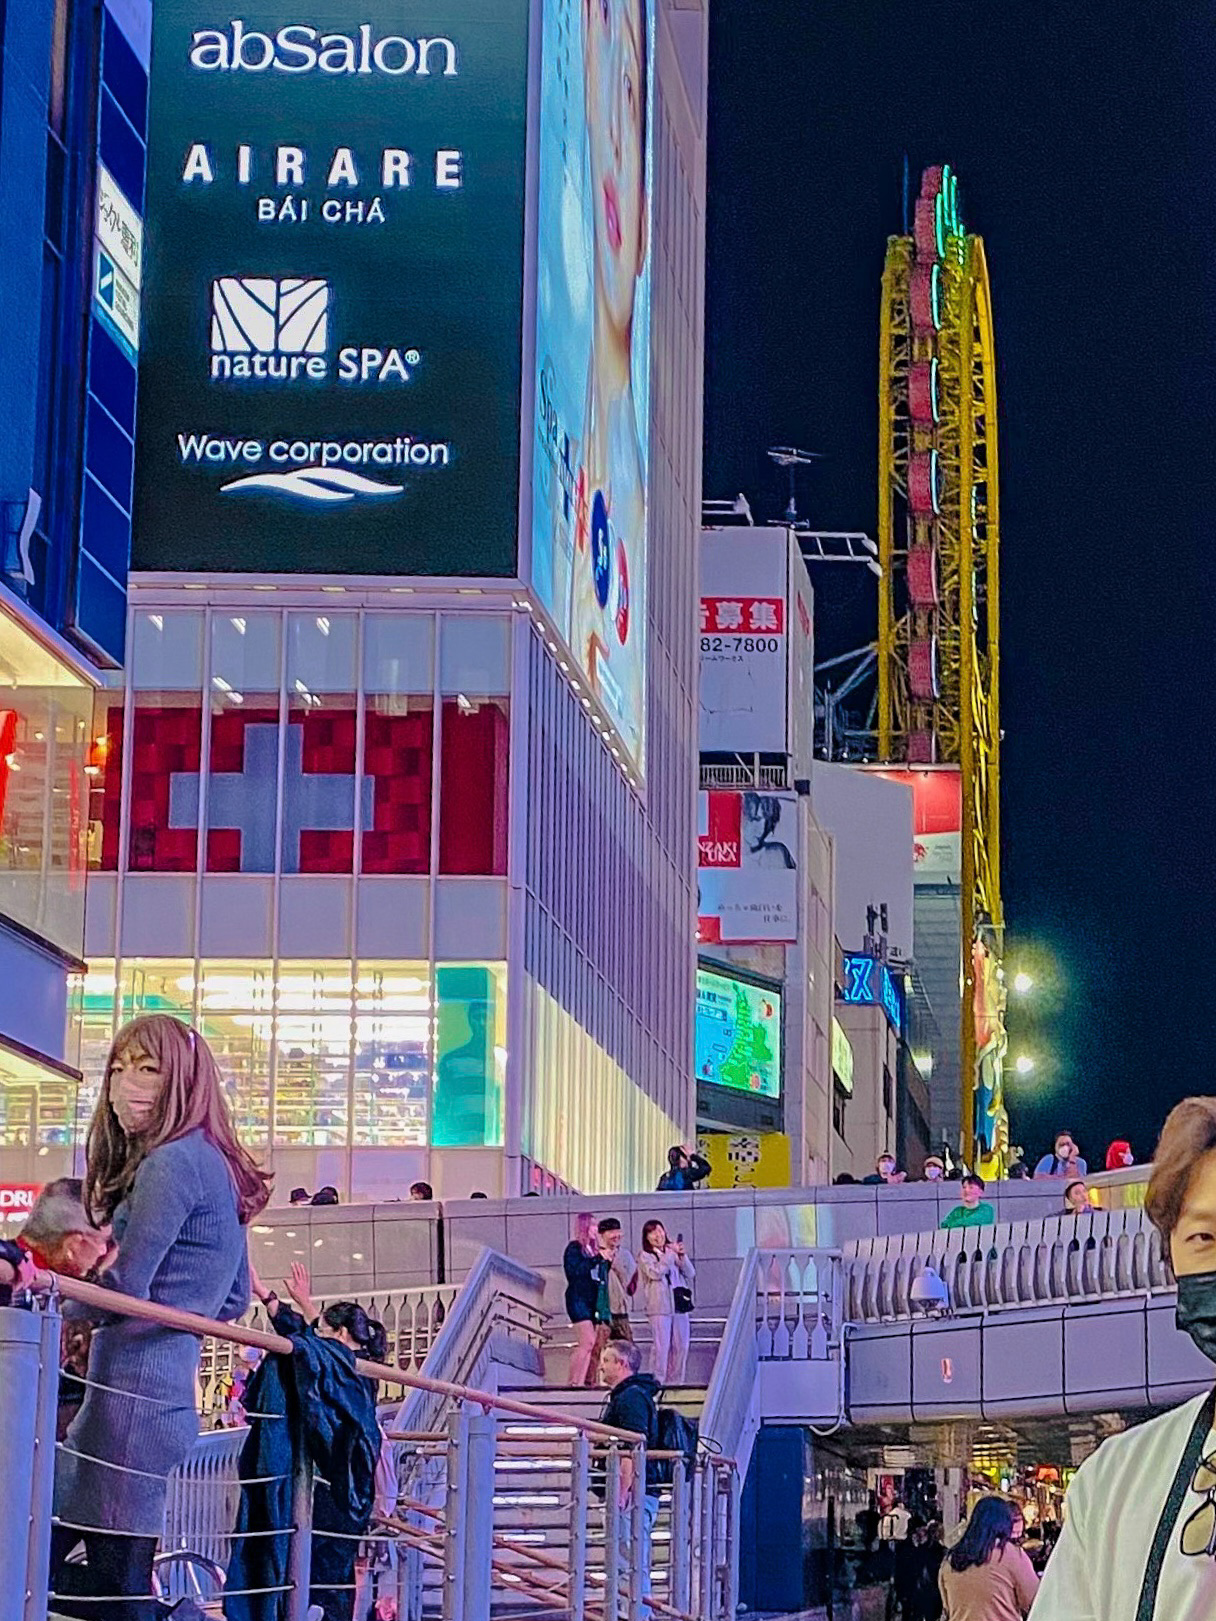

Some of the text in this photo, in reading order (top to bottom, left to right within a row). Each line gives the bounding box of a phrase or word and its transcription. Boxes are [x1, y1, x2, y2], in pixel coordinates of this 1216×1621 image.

[190, 19, 458, 75] abSalon
[183, 144, 460, 188] AIRARE
[211, 353, 328, 380] nature
[177, 433, 450, 467] Wave corporation
[700, 637, 778, 653] 82-7800
